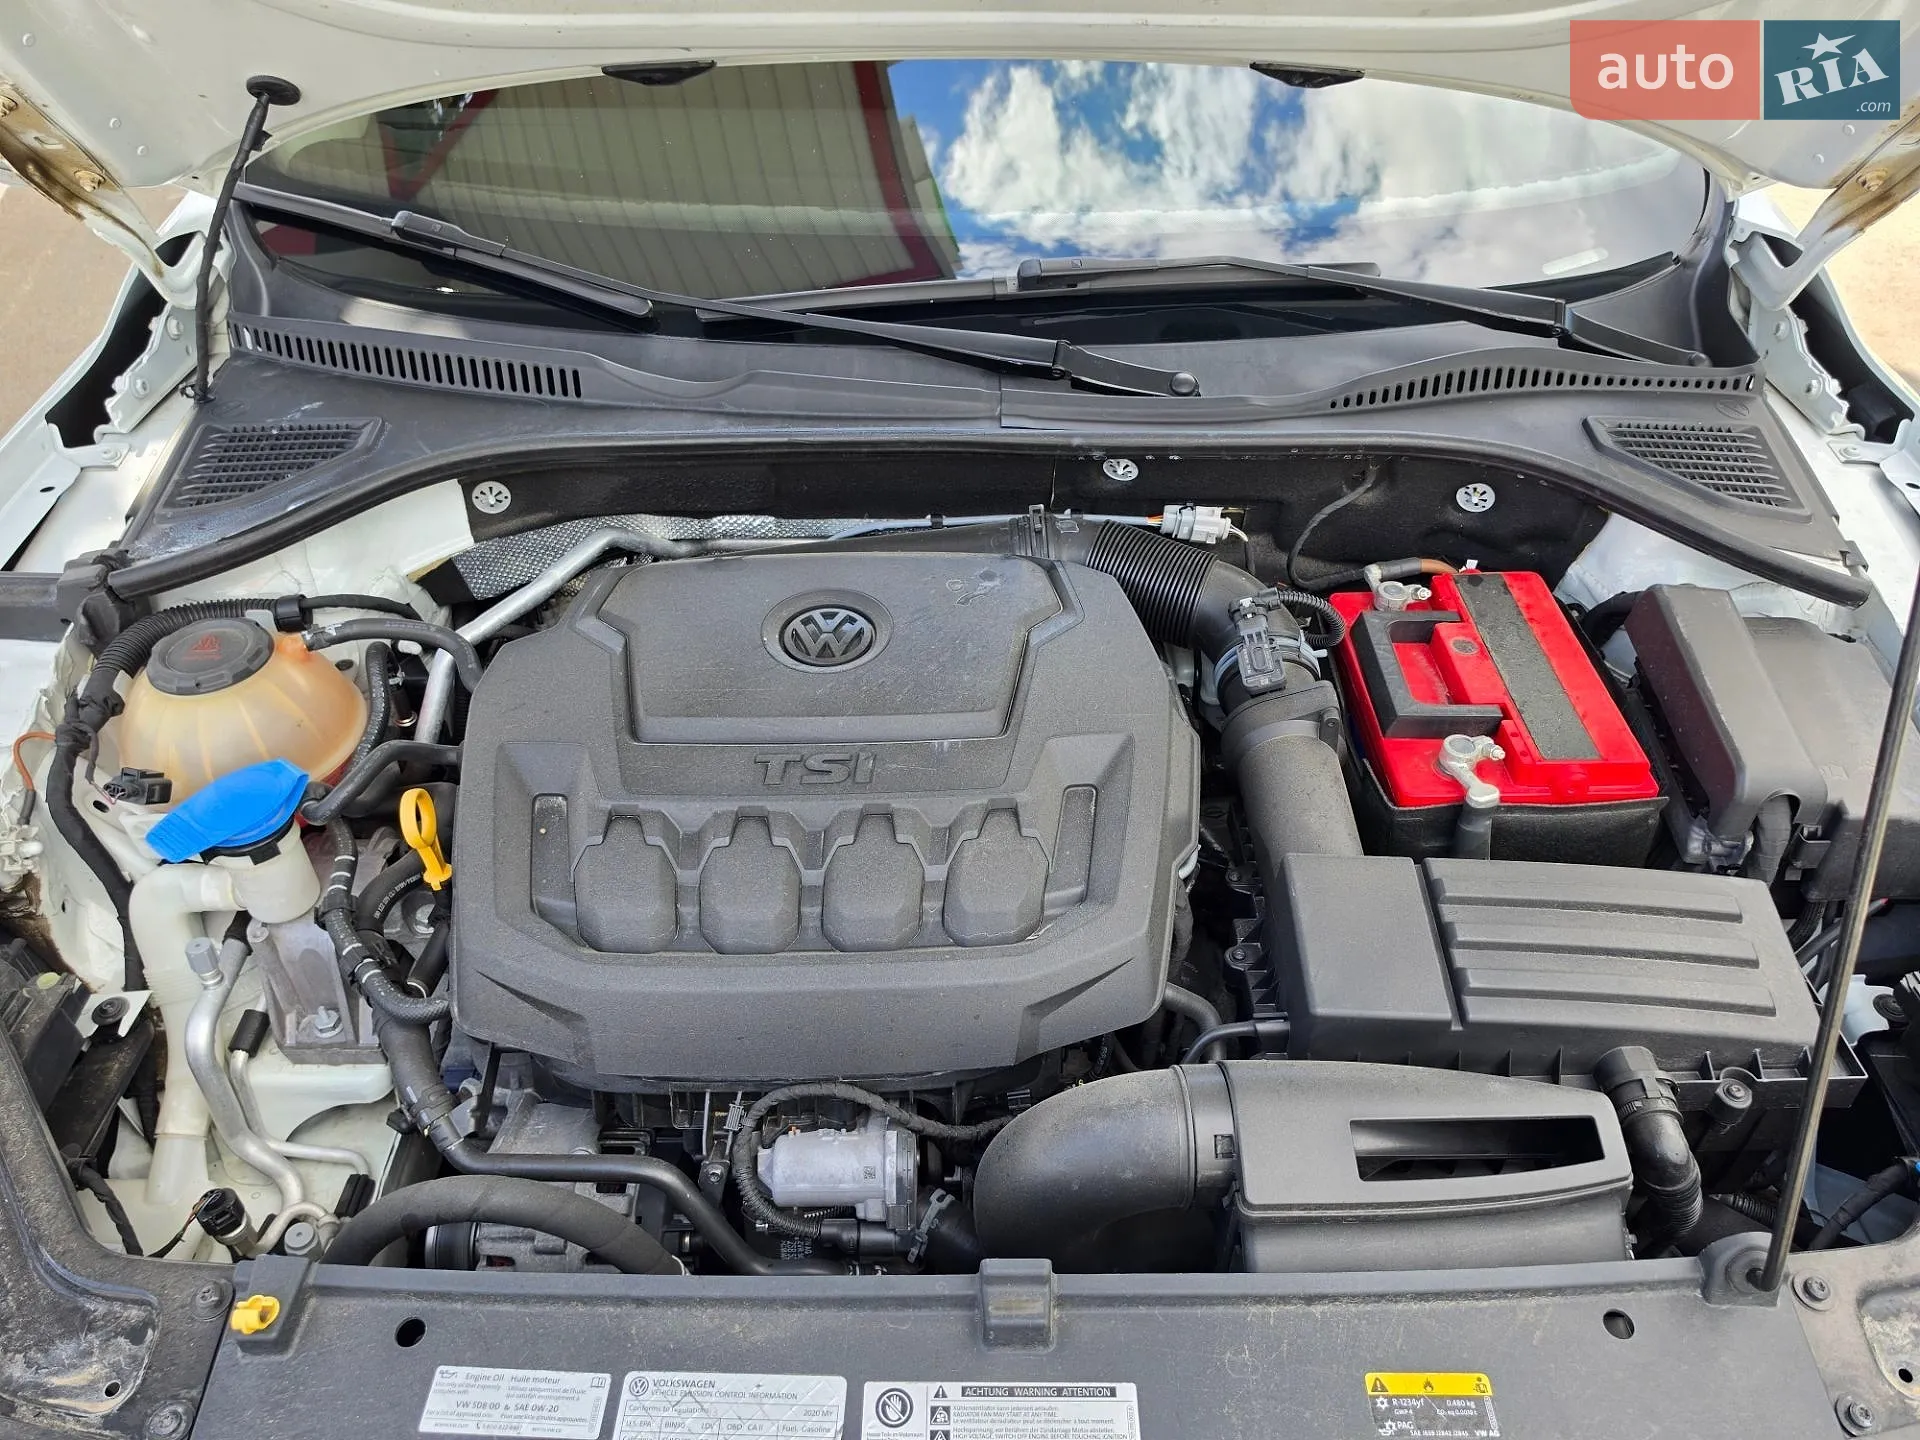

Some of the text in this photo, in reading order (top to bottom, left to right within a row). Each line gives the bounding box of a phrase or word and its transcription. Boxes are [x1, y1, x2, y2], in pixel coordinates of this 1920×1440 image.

[754, 752, 877, 785] TSI
[465, 1372, 505, 1382] Engine Oil
[510, 1375, 561, 1385] Huile moteur
[652, 1379, 716, 1389] VOLKSWAGEN
[651, 1388, 798, 1400] VEHICLE EMISSION CONTROL INFORMATION
[965, 1387, 1111, 1397] ACHTUNG WARNING ATTENTION
[456, 1400, 471, 1408] VW
[472, 1401, 487, 1409] 508
[489, 1402, 501, 1410] 00
[514, 1403, 529, 1411] SAE
[531, 1404, 559, 1413] 0W-20
[1391, 1397, 1424, 1408] R-1234yf
[803, 1409, 820, 1417] 2020
[801, 1425, 831, 1433] Gasoline
[1397, 1420, 1414, 1429] PAG
